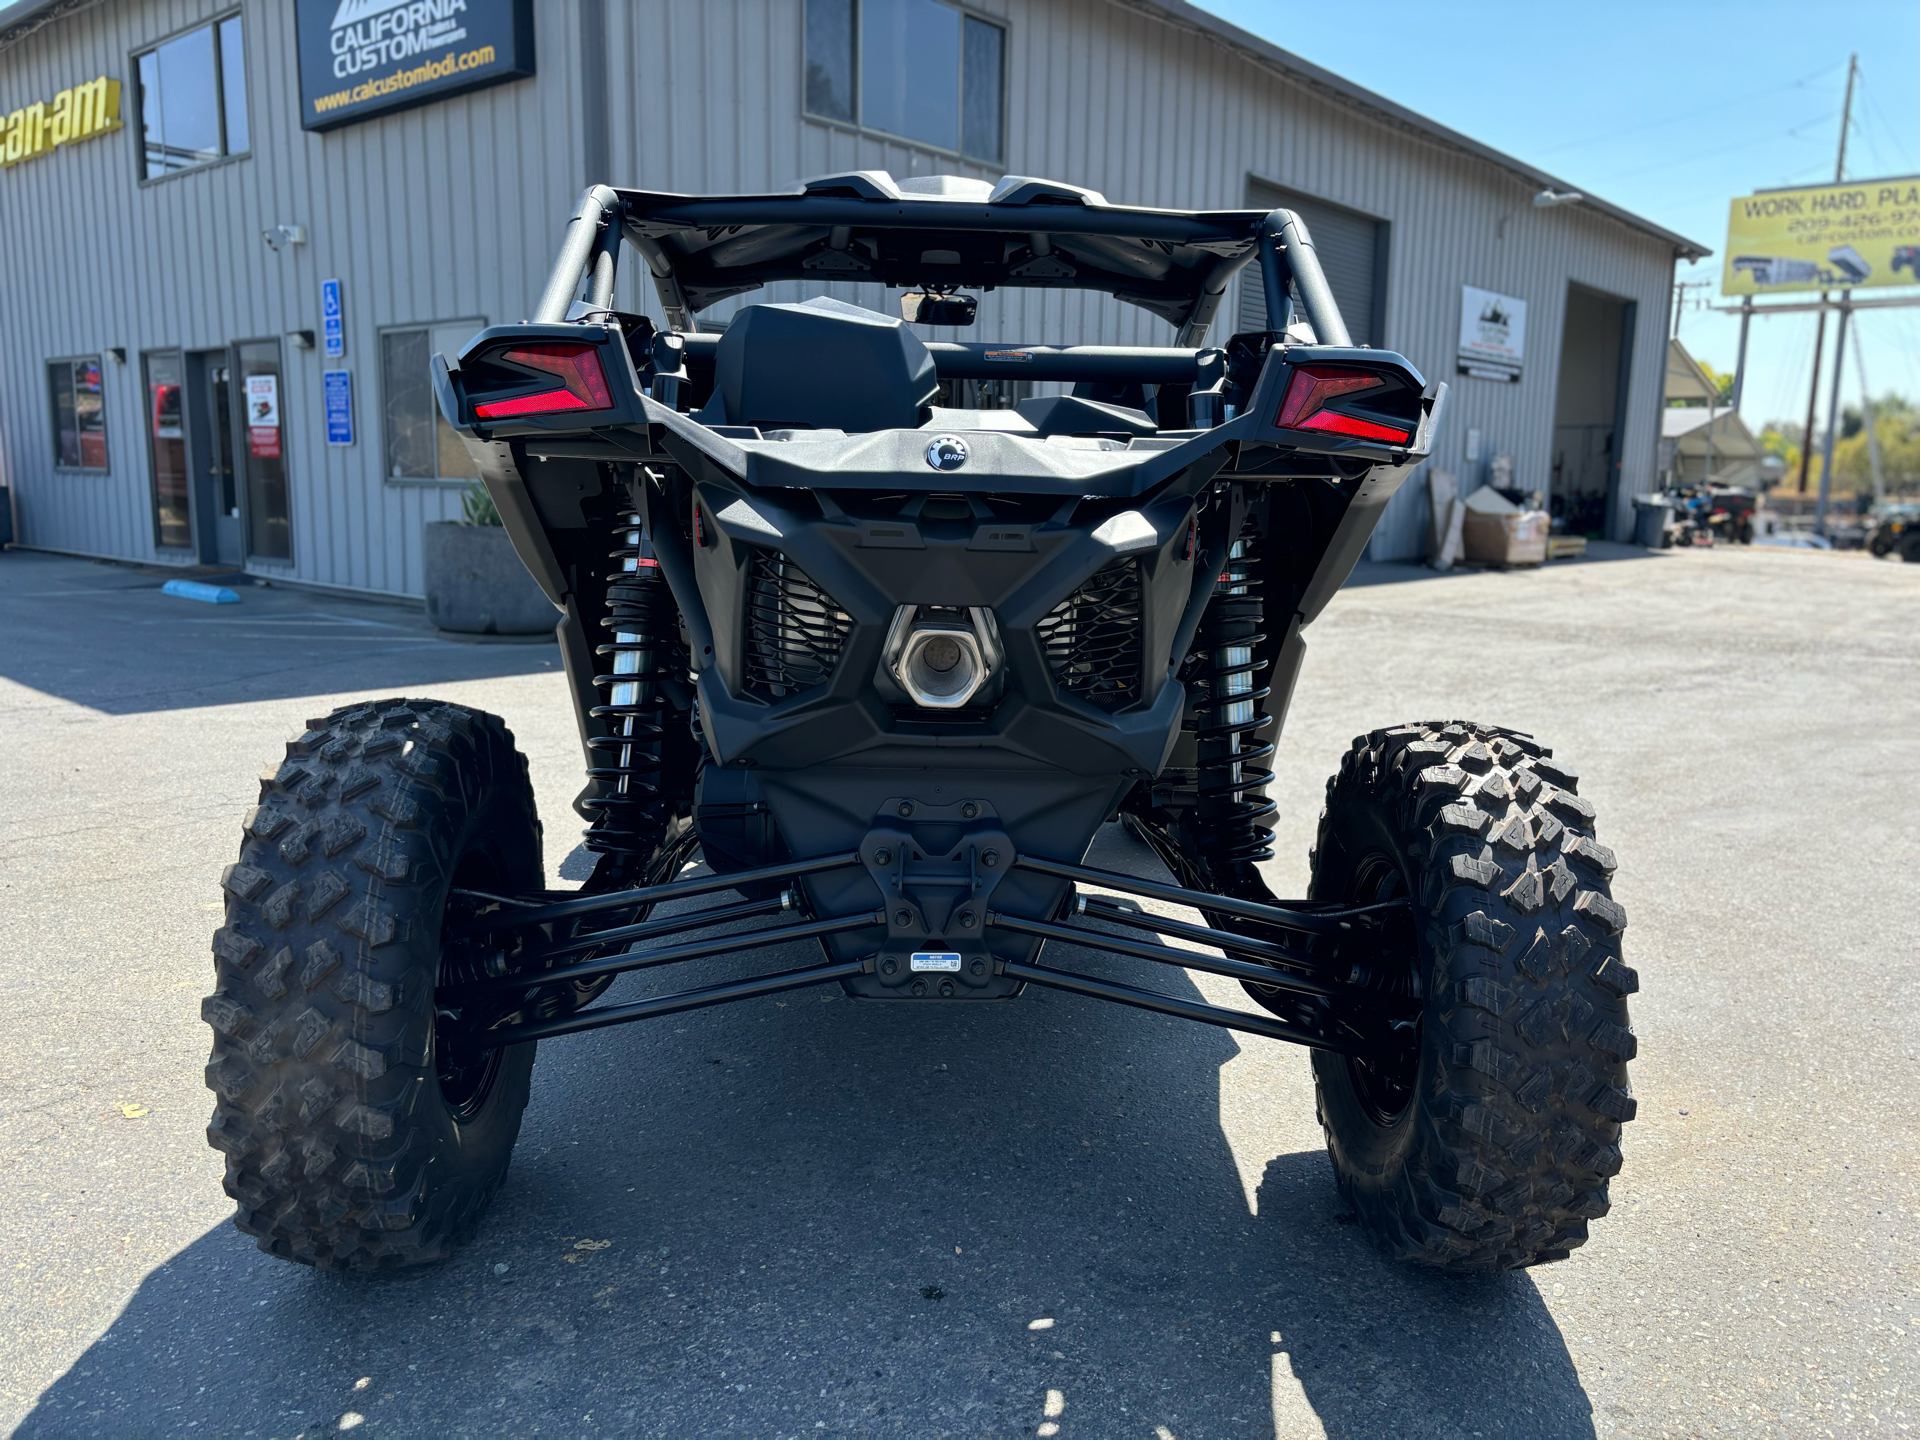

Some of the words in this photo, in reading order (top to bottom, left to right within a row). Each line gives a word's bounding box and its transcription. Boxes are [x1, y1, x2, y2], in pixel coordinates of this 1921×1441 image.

[333, 29, 428, 78] CUSTOM
[314, 46, 495, 113] www.calcustomlodi.com
[1744, 197, 1805, 218] WORK
[1787, 210, 1920, 232] 209-426-97
